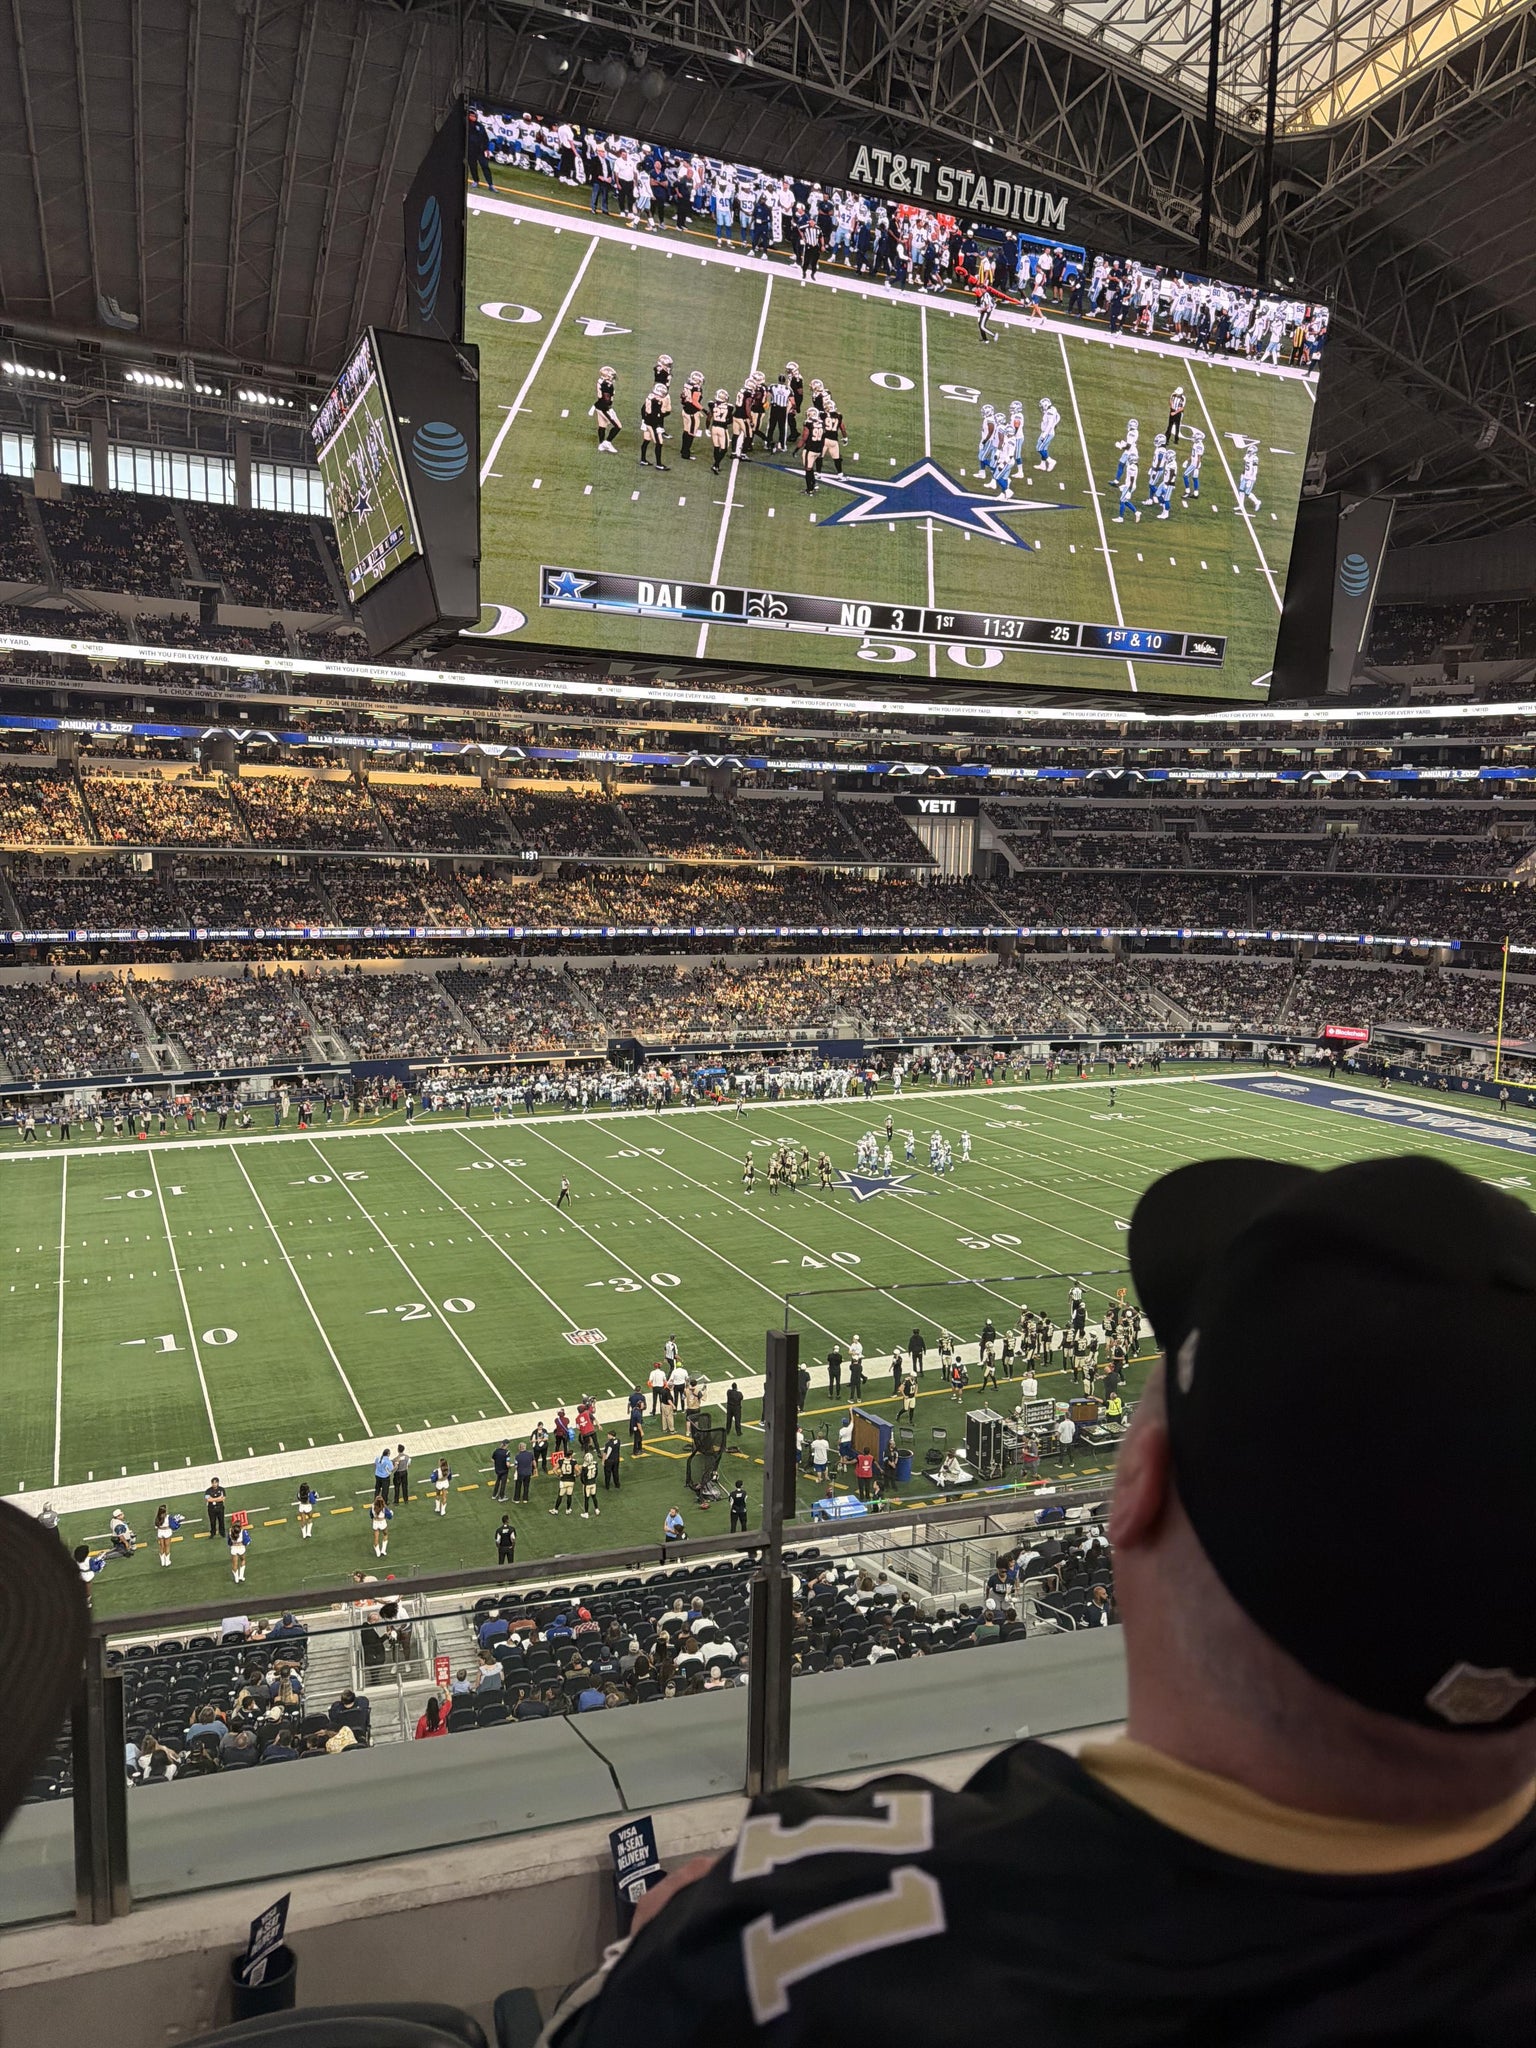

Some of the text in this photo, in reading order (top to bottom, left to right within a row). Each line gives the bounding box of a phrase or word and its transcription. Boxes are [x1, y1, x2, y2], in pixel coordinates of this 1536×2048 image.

[850, 145, 1068, 231] AT&T STADIUM
[840, 213, 852, 224] 47
[712, 408, 728, 422] 27
[825, 418, 839, 431] 97
[638, 581, 724, 614] DAL 0
[840, 603, 904, 631] NO 3
[936, 614, 1070, 642] 1ST 11:37 :25
[1106, 631, 1162, 648] 1ST & 10
[58, 720, 97, 731] JANUARY
[111, 723, 133, 732] 2027
[308, 735, 332, 744] DALLAS
[334, 737, 364, 745] COWBOYS
[577, 750, 606, 760] JANUARY
[918, 799, 956, 813] YETI
[956, 1233, 1022, 1250] 50
[800, 1251, 862, 1270] 40
[608, 1272, 682, 1293] 30
[394, 1297, 477, 1322] 20
[153, 1327, 238, 1354] 10
[574, 1334, 602, 1344] NFL
[618, 1826, 637, 1841] VISA
[617, 1834, 644, 1857] IN-SEAT
[617, 1845, 649, 1871] DELIVERY
